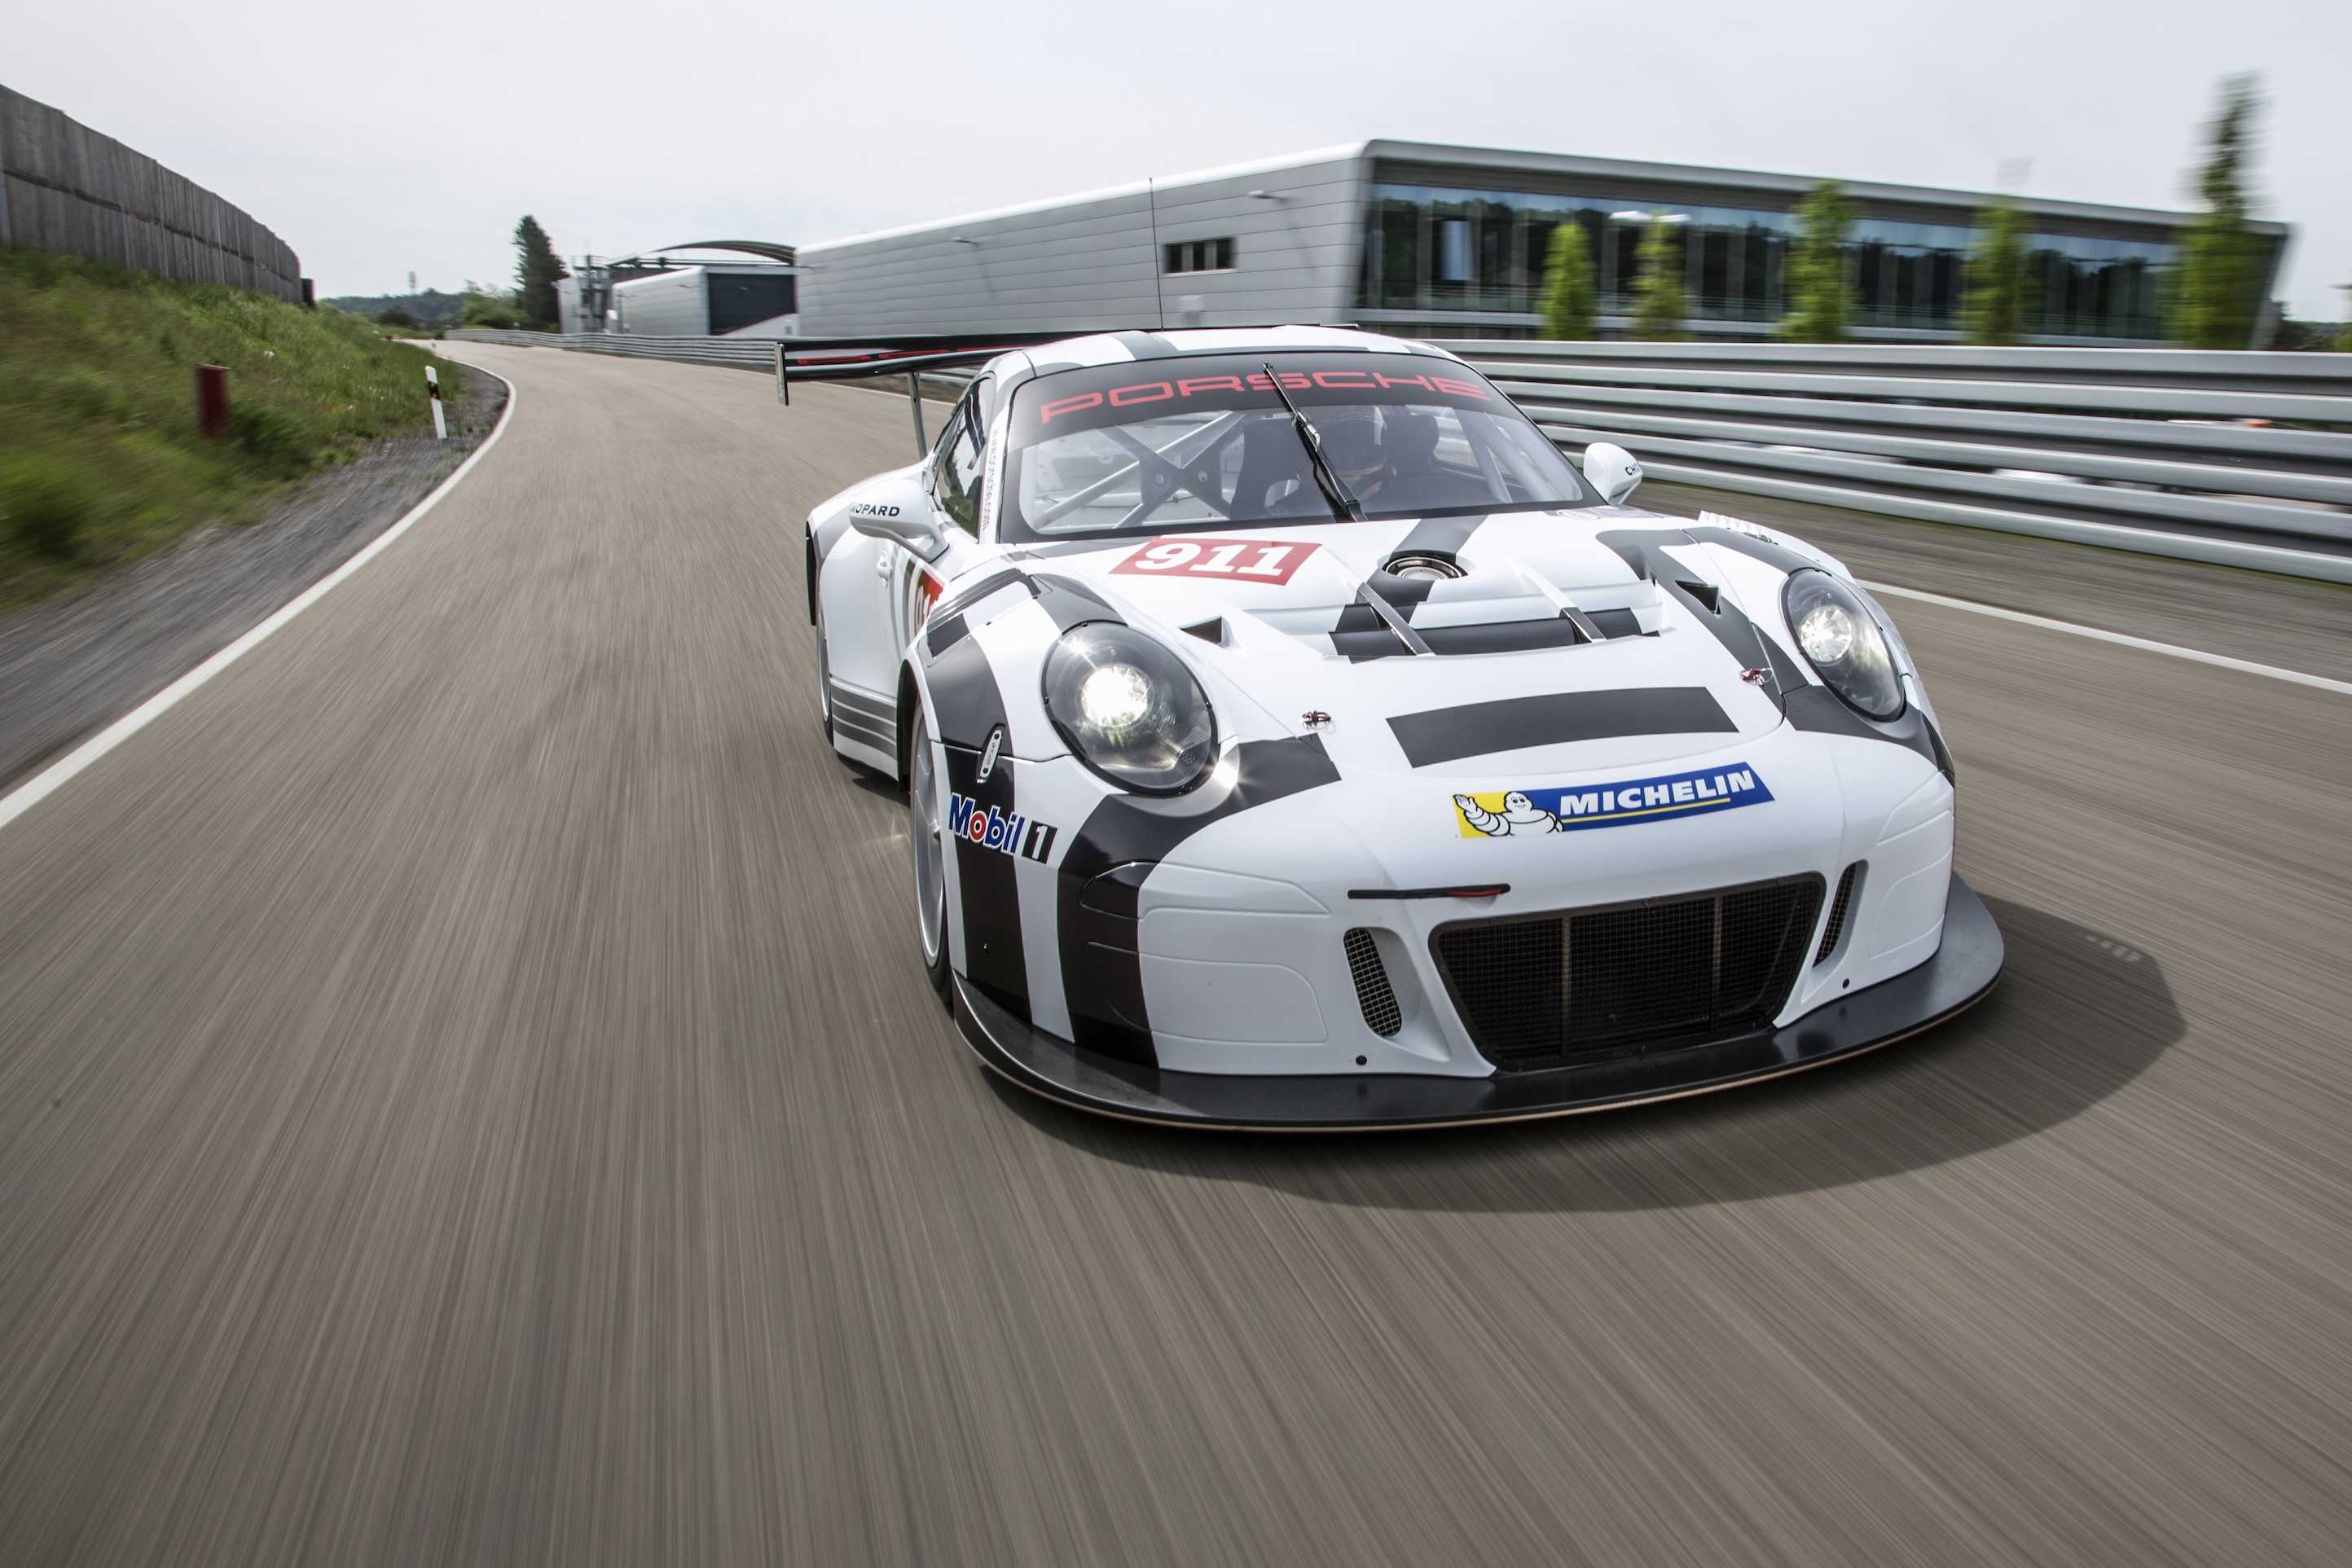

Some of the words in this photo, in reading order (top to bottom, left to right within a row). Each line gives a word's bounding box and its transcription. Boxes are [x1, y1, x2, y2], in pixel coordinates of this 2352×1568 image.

[1040, 371, 1490, 424] PORSCHE
[1134, 543, 1290, 577] 911
[1561, 770, 1756, 815] MICHELIN
[947, 793, 1027, 856] Mobil
